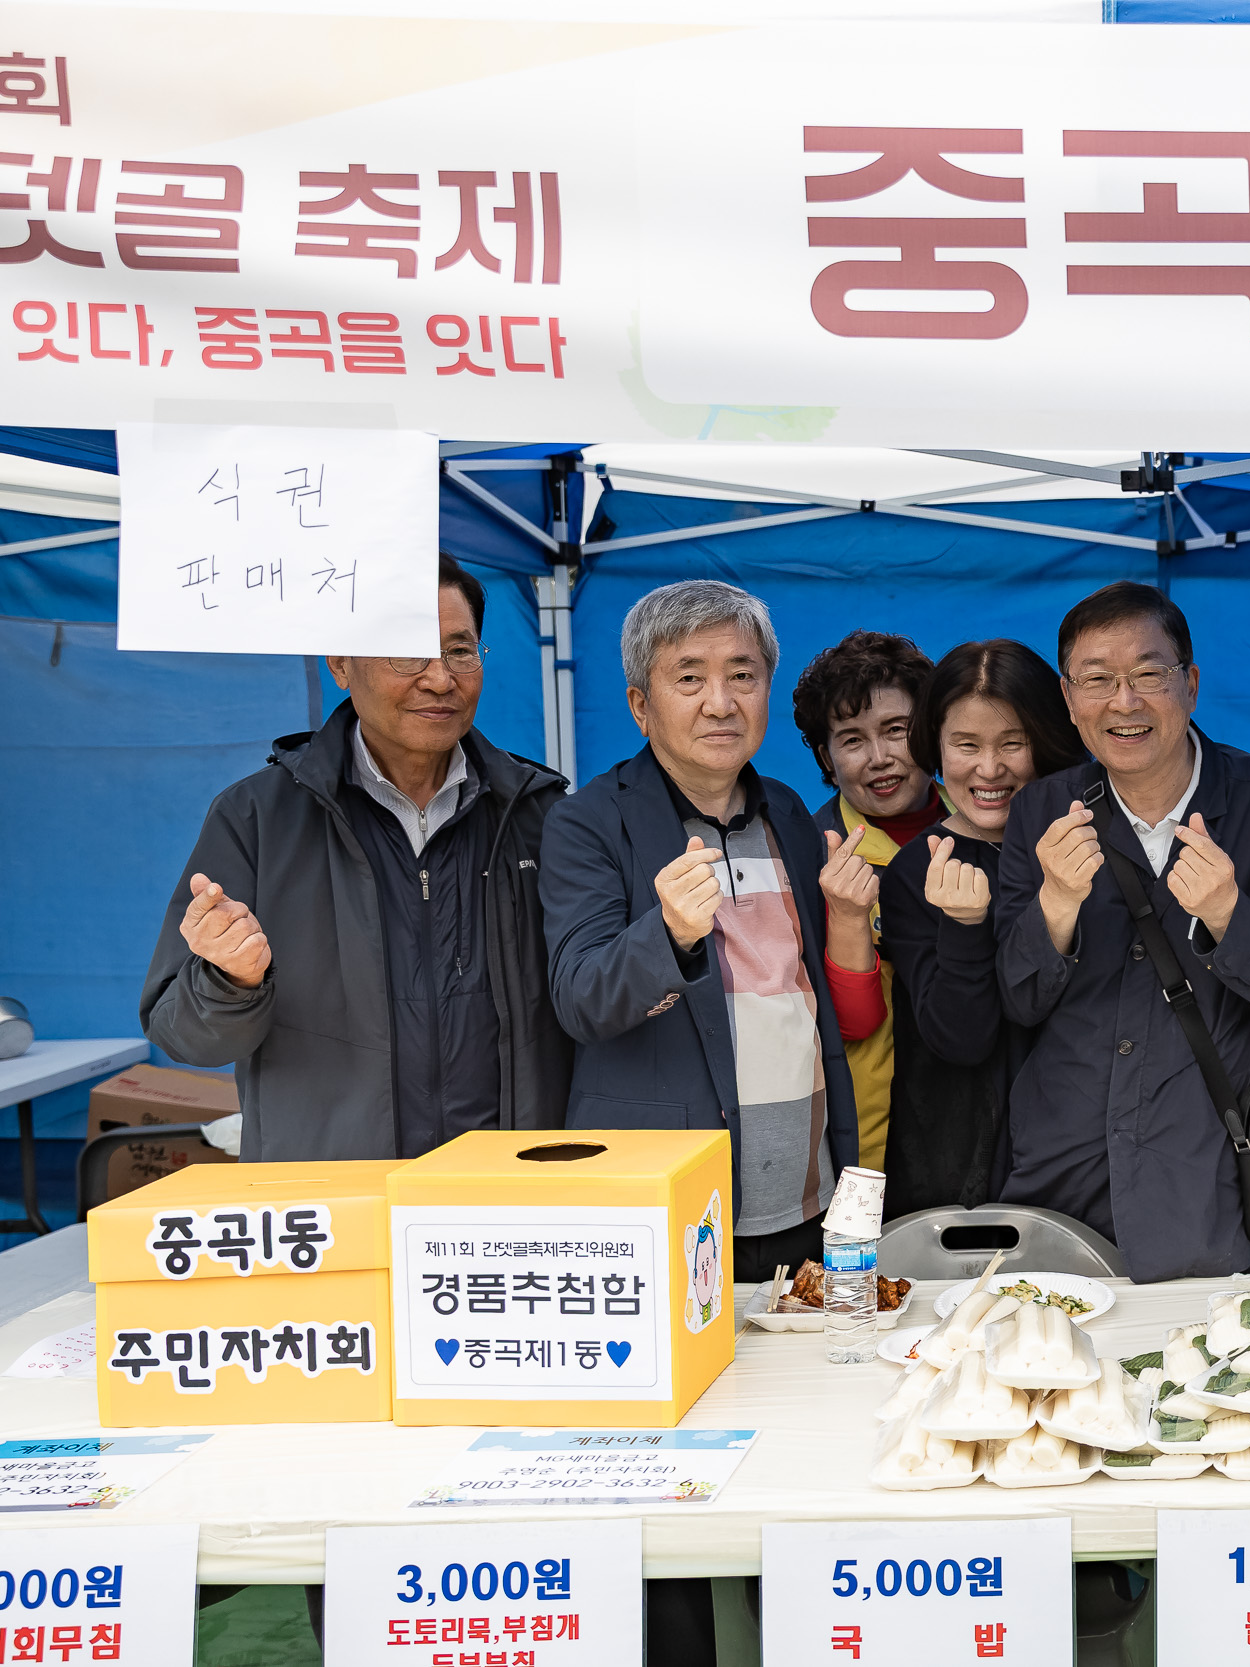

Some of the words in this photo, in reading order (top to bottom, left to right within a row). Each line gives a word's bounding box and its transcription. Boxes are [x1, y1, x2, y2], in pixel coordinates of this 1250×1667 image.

[0, 53, 70, 124] 회
[296, 165, 560, 283] 축제
[13, 301, 173, 366] 잇다,
[195, 307, 406, 374] 중곡을
[426, 315, 566, 378] 잇다
[153, 1211, 327, 1274] 중곡1동
[425, 1242, 474, 1257] 제11회
[423, 1272, 645, 1315] 경품추첨함
[112, 1326, 370, 1387] 주민자치회
[465, 1340, 601, 1369] 중곡제1동
[13, 1442, 114, 1454] 계좌이체
[535, 1453, 659, 1463] MG새마을금고
[568, 1435, 663, 1446] 계좌이체
[457, 1477, 693, 1491] 9003-2902-3632-6
[565, 1465, 677, 1475] (주민자치회)
[397, 1559, 570, 1606] 3,000원
[833, 1557, 1002, 1600] 5,000원
